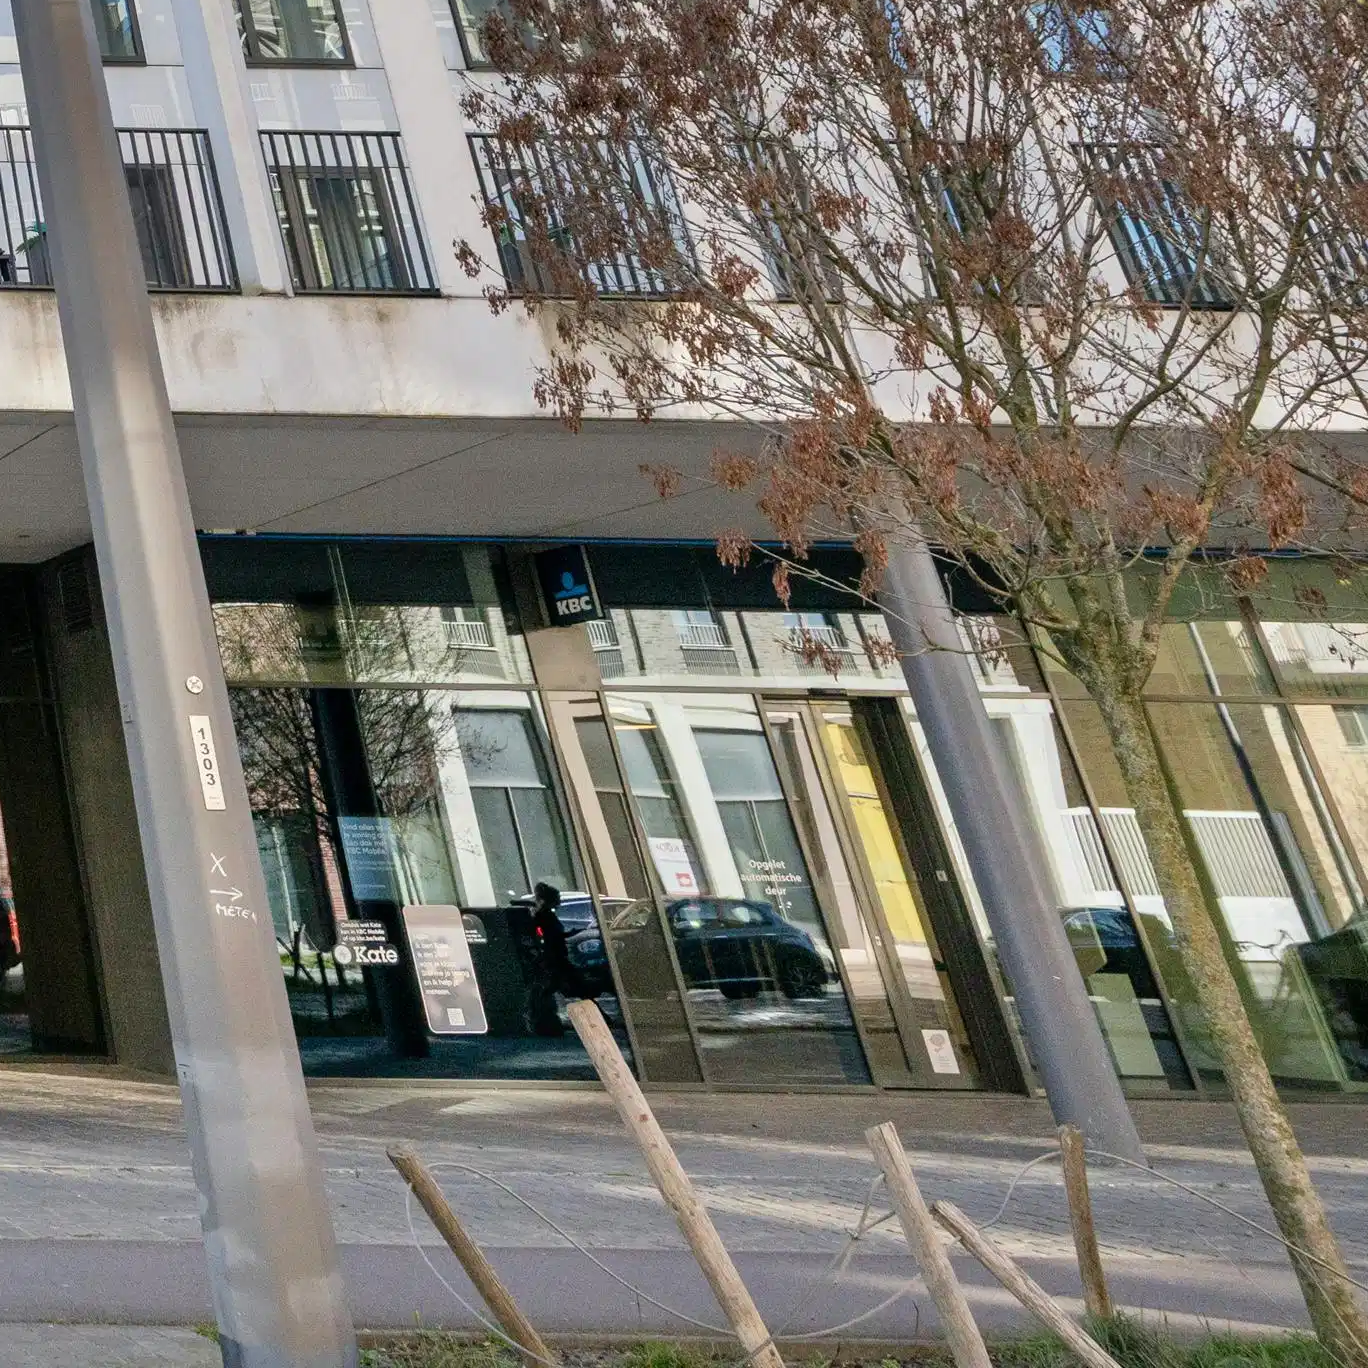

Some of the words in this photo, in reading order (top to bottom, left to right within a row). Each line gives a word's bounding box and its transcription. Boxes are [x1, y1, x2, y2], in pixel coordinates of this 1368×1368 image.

[556, 596, 593, 616] KBC
[198, 727, 216, 786] 1303
[748, 859, 787, 871] Opgelet
[740, 873, 802, 883] automatische
[764, 887, 787, 896] deur
[355, 945, 399, 964] Kate
